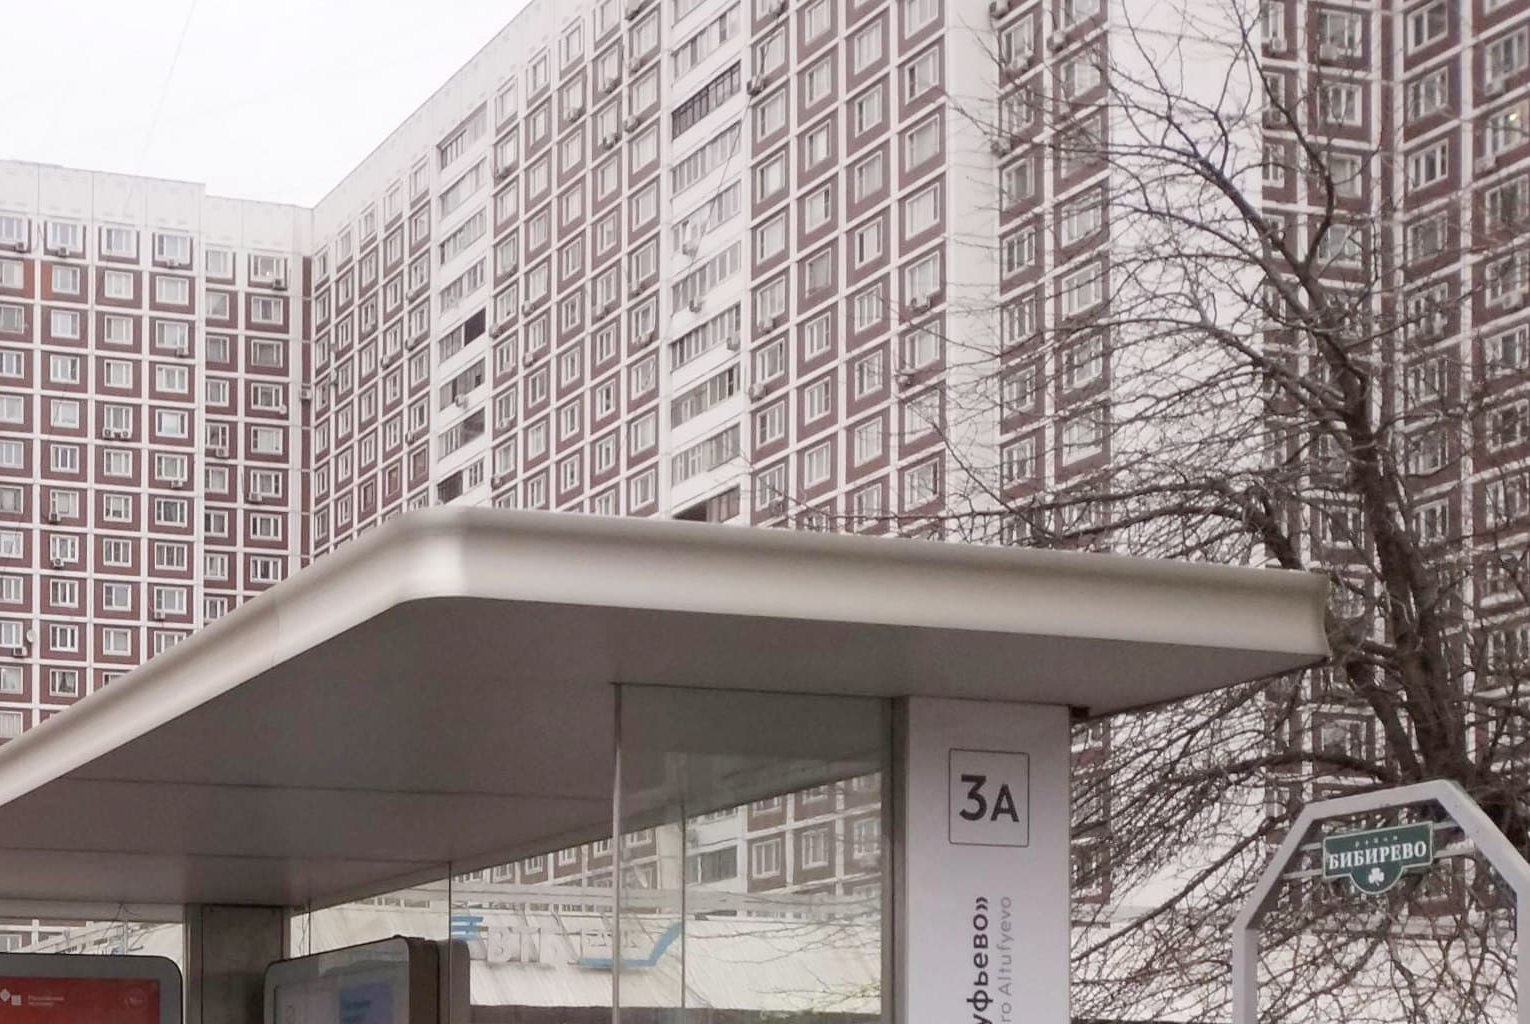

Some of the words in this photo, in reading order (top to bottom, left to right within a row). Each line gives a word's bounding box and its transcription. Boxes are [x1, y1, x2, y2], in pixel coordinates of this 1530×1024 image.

[958, 773, 1020, 824] 3А
[1329, 840, 1427, 870] БИБИРЕВО
[998, 896, 1014, 997] Altufyevo
